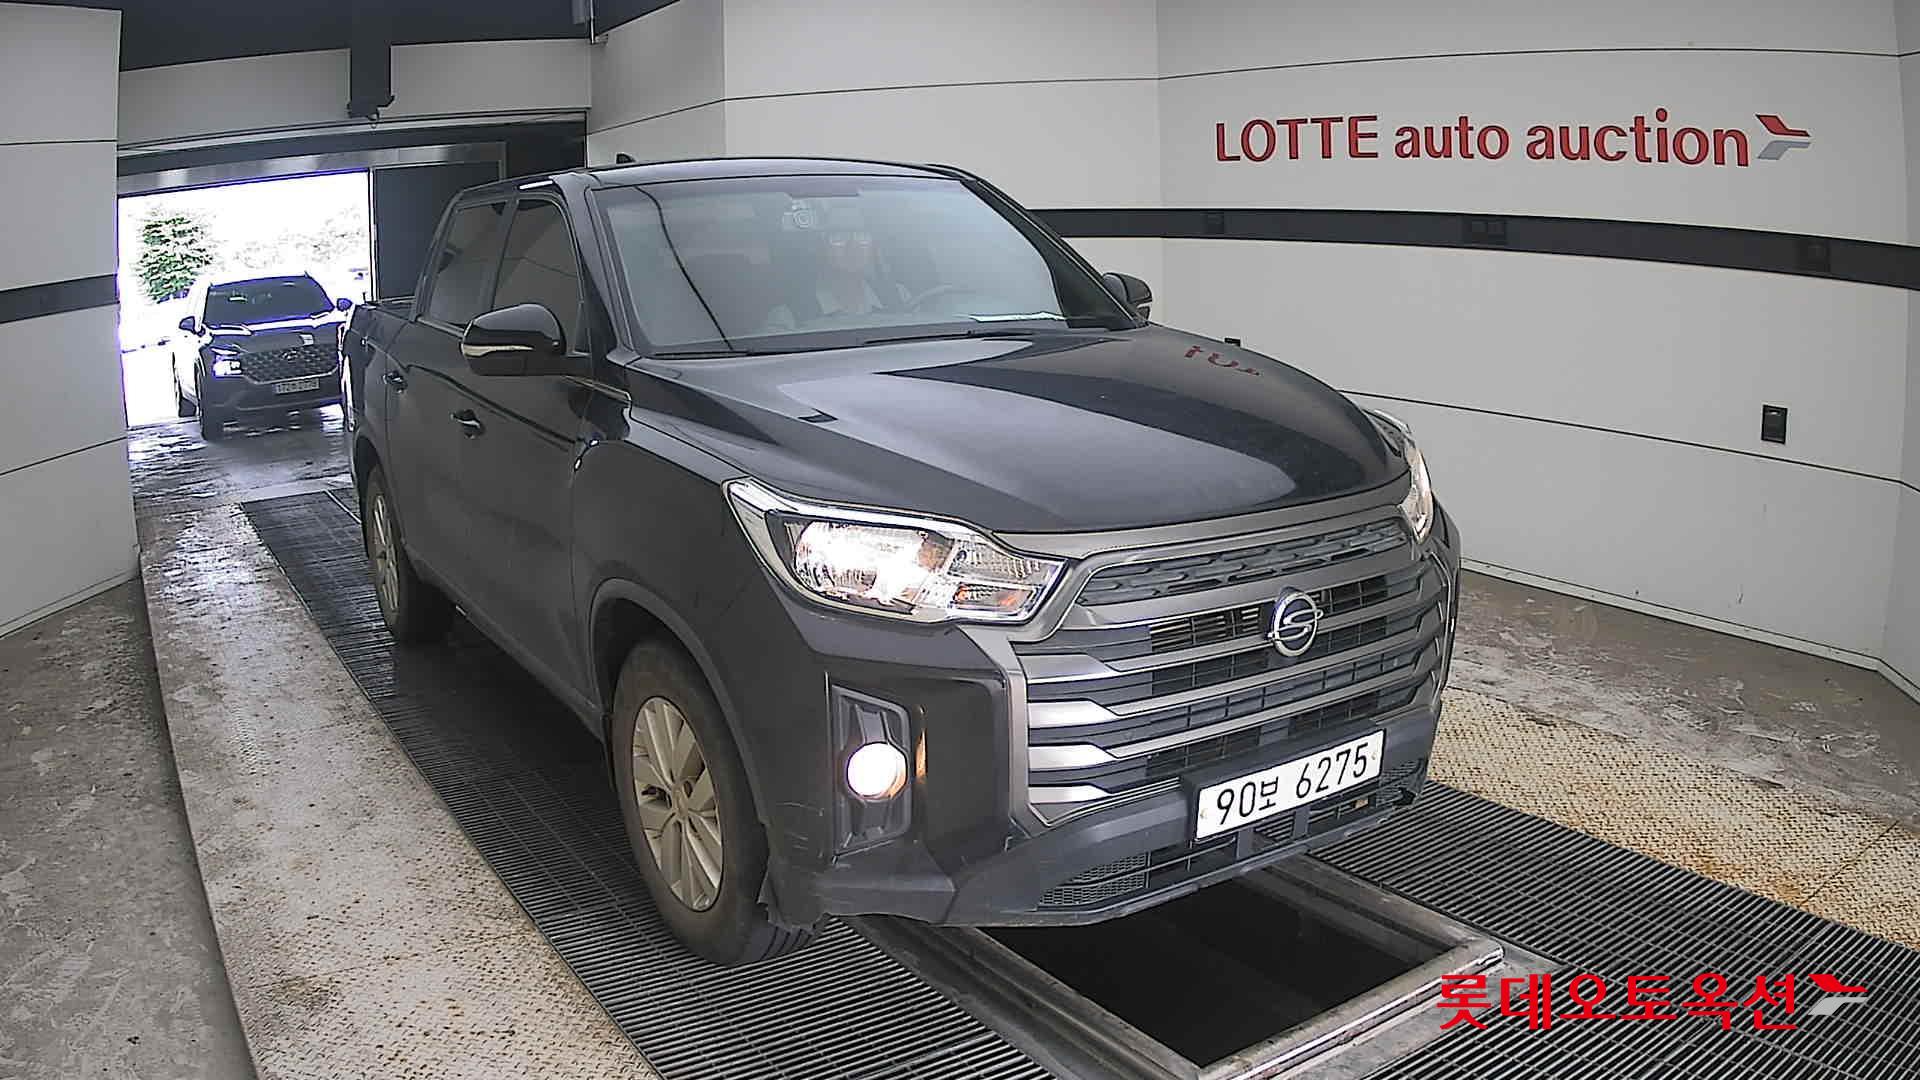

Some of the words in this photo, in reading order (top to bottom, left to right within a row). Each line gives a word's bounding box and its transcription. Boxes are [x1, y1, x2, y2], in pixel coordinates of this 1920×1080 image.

[1216, 114, 1379, 162] LOTTE
[1394, 115, 1510, 161] auto
[1526, 107, 1750, 168] auction
[1217, 776, 1280, 825] 90보
[1296, 742, 1369, 799] 6275
